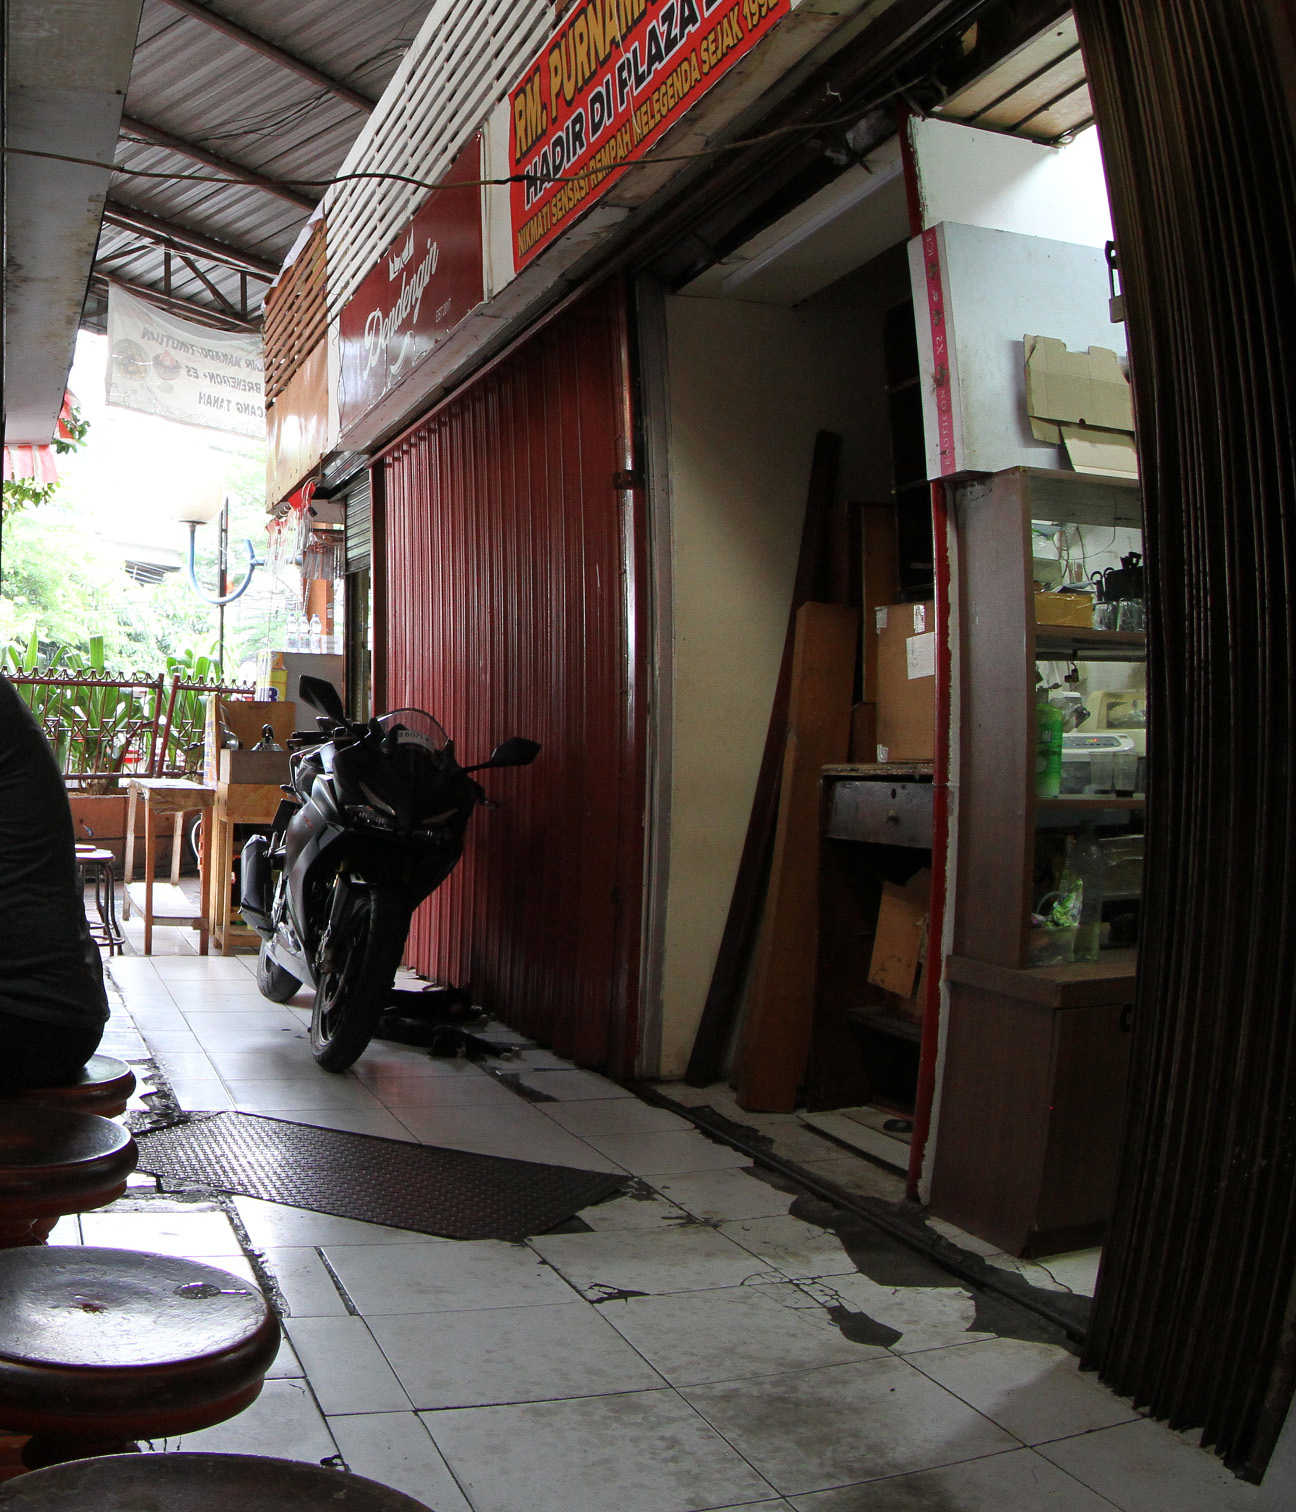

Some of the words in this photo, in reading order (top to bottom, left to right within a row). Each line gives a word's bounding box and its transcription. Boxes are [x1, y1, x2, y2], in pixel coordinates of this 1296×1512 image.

[513, 68, 549, 165] RM.
[517, 201, 552, 259] NIKMATI
[551, 163, 590, 226] SENSASI
[589, 121, 633, 191] REMPAH
[631, 48, 702, 147] MELEGENDA
[700, 2, 744, 75] SEJAK
[742, 0, 779, 32] 199
[524, 107, 586, 211] HADIR
[588, 72, 615, 142] DI
[615, 0, 701, 113] PLAZA
